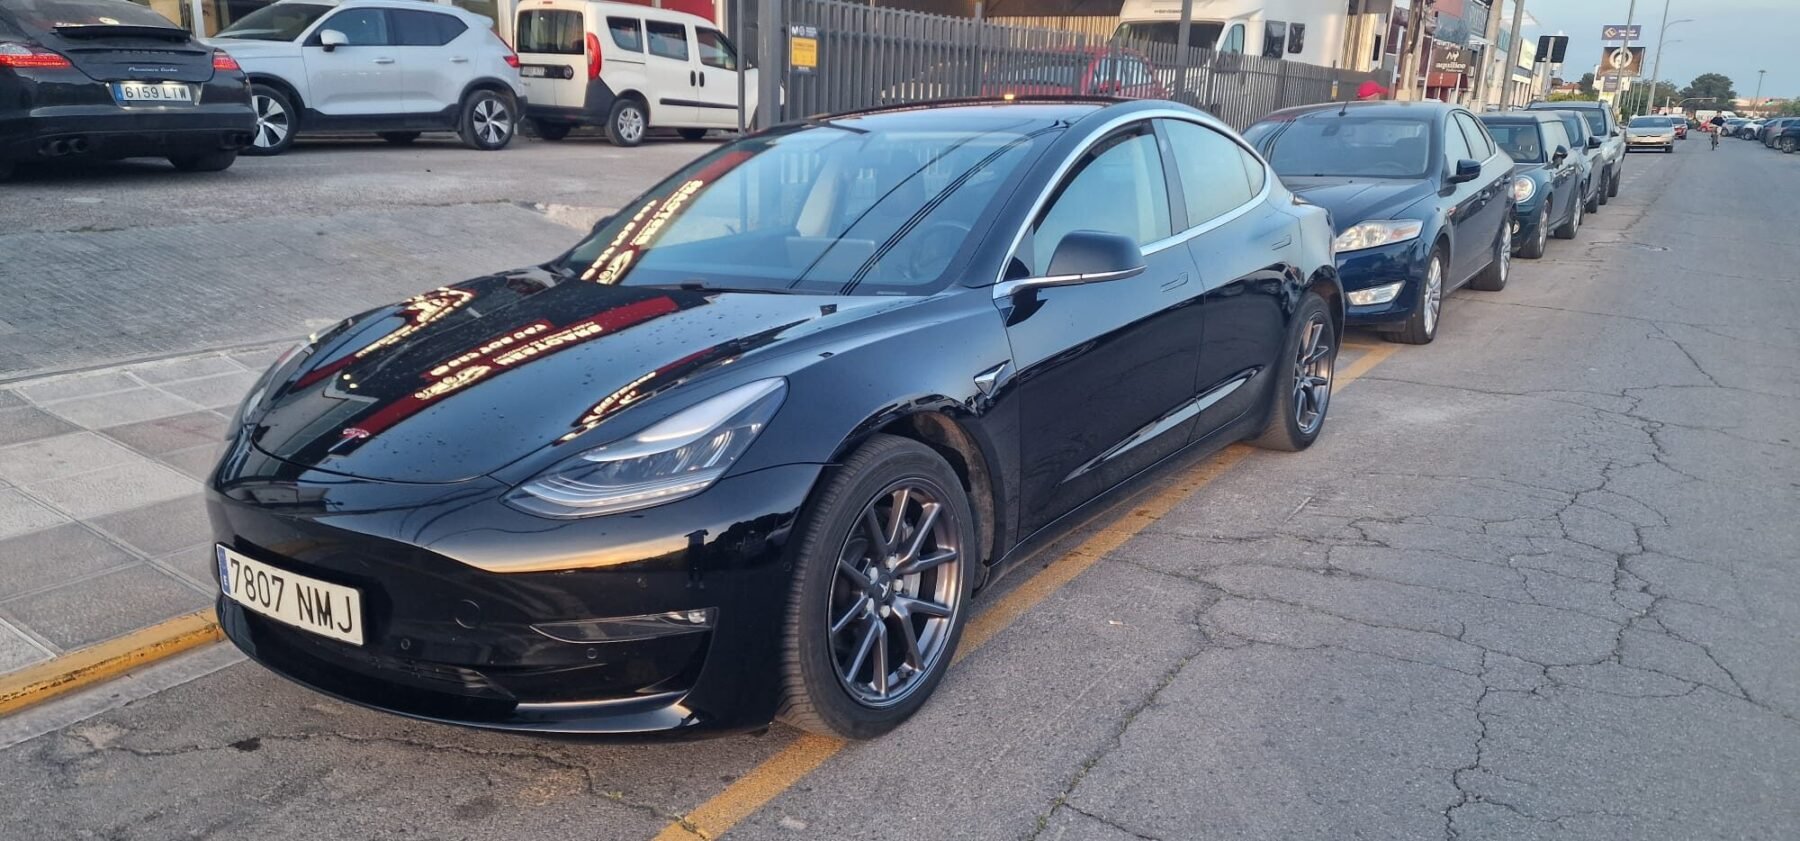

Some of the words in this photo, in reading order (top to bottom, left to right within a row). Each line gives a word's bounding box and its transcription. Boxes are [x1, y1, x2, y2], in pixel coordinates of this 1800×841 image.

[125, 86, 159, 98] 6159
[162, 87, 187, 99] LTW
[230, 558, 285, 612] 7807
[295, 582, 353, 633] NMJ
